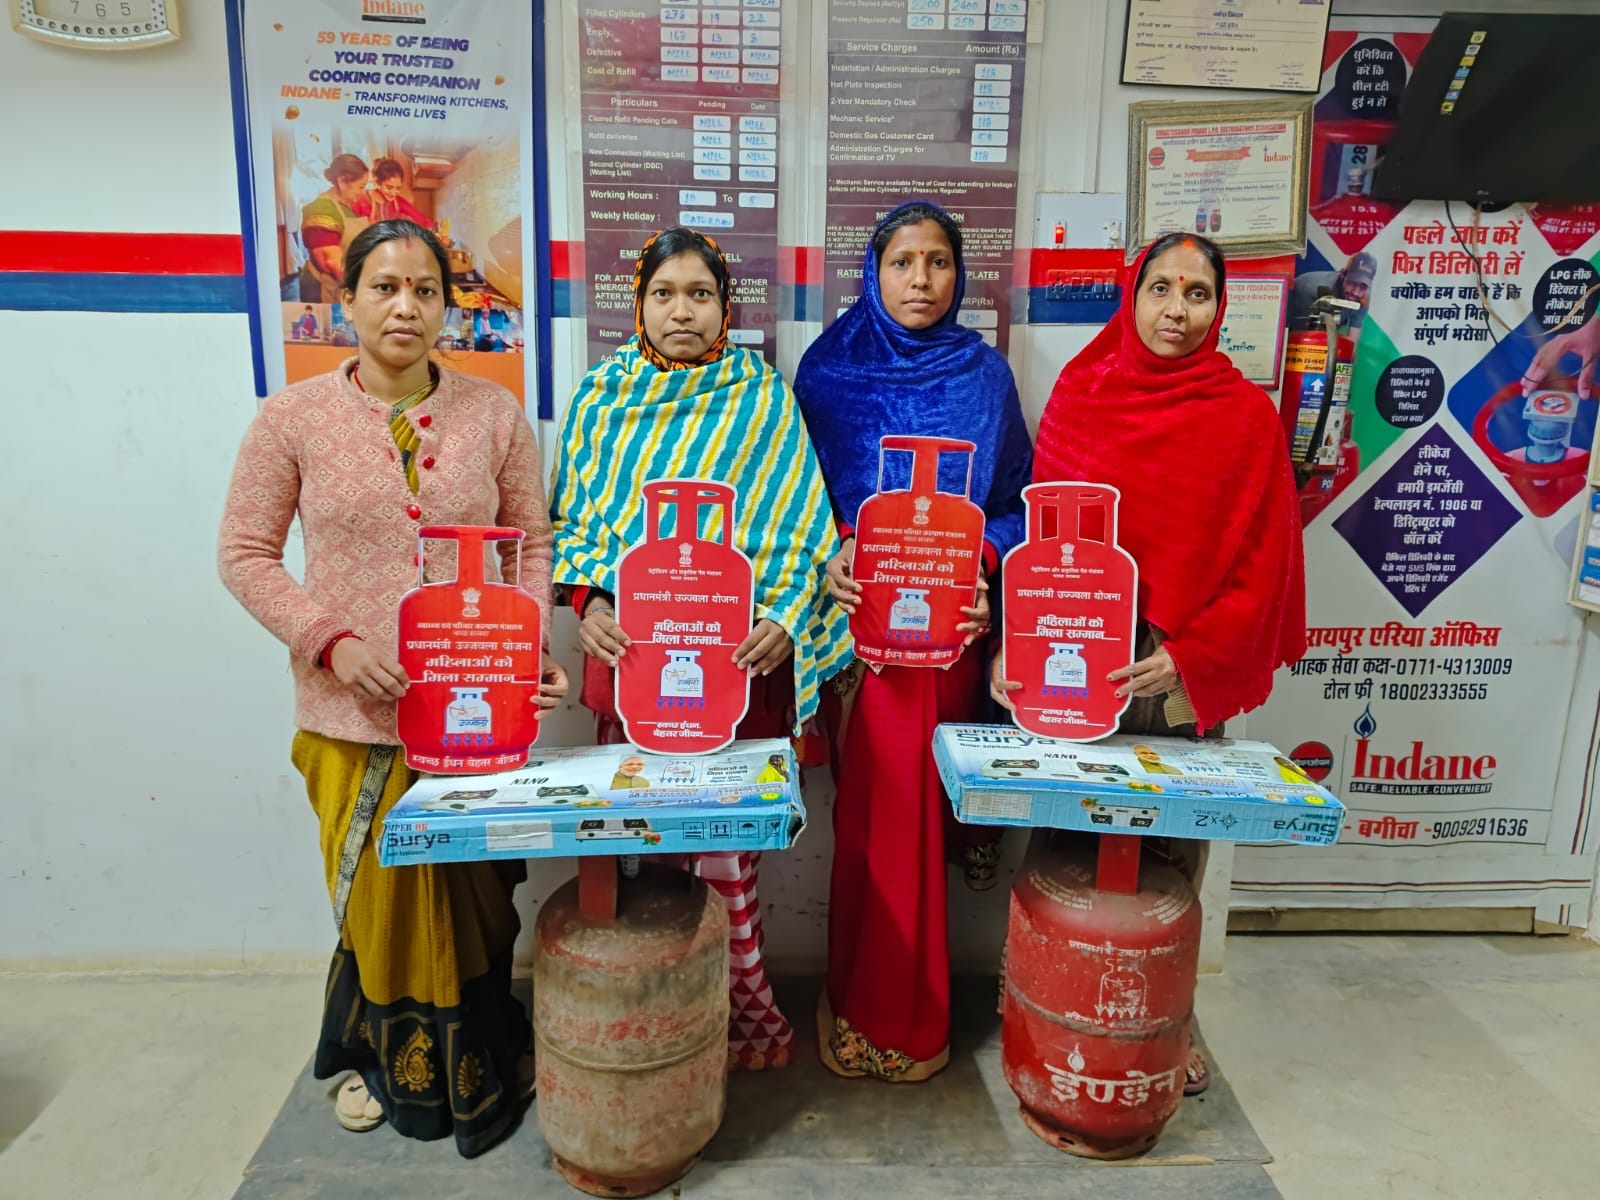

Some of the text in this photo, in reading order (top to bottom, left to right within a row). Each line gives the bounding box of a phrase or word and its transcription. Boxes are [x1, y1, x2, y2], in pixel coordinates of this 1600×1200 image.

[96, 3, 106, 17] 6
[120, 2, 131, 16] 5
[362, 0, 424, 15] Indane
[317, 31, 469, 51] 59 YEARS OF BEING
[847, 42, 918, 54] Service Charges
[966, 44, 1019, 55] Amount (Rs)
[334, 50, 454, 70] YOUR TRUSTED
[587, 67, 616, 75] Cost of
[831, 64, 960, 76] Installation Administration Charges
[1372, 64, 1384, 76] कि
[308, 69, 480, 90] COOKING COMPANION
[830, 80, 842, 88] Hot
[864, 82, 902, 90] Inspection
[1352, 80, 1372, 92] सील
[280, 84, 508, 110] INDANE TRANSFORMING KITCHENS,
[610, 98, 658, 108] Particulars
[854, 98, 917, 107] Mandatory Check
[1352, 95, 1387, 110] हुई न हो
[699, 101, 726, 109] Pending
[348, 105, 446, 120] ENRICHING LIVES
[830, 145, 881, 153] Administration
[883, 146, 912, 154] Charges
[1352, 145, 1368, 164] 28
[590, 190, 653, 201] Working Hours
[722, 194, 733, 202] To
[590, 211, 656, 222] Weekly Holiday
[1404, 219, 1524, 246] पहले करें
[1392, 250, 1425, 274] फिर
[1504, 250, 1526, 275] लें
[595, 274, 611, 282] FOR
[837, 269, 864, 278] RATES
[1550, 268, 1592, 280] LPG लीक
[736, 288, 768, 296] INDANE,
[1390, 282, 1522, 300] क्योंकि हम हैं कि
[1549, 282, 1579, 295] डिटेक्टर
[841, 296, 860, 304] HOT
[1545, 298, 1573, 310] लीकेज
[1416, 303, 1461, 320] आपको
[600, 330, 622, 338] Name
[1414, 324, 1489, 345] संपूर्ण भरोसा
[1412, 390, 1428, 398] LPG
[1418, 444, 1451, 458] लीकेज
[1414, 462, 1432, 476] होने
[1398, 480, 1424, 494] हमारी
[1374, 496, 1482, 512] हेल्पलाइन 1906 या
[1442, 514, 1456, 528] को
[1404, 531, 1444, 544] कॉल करें
[862, 542, 974, 559] प्रधानमंत्री योजना
[877, 558, 954, 573] महिलाओं को
[1408, 564, 1424, 572] SMS
[874, 571, 955, 588] मिला सम्मान
[633, 590, 671, 602] प्रधानमंत्री
[712, 592, 739, 604] योजना
[1016, 588, 1054, 598] प्रधानमंत्री
[1094, 590, 1121, 601] योजना
[654, 619, 722, 633] महिलाओं को
[1037, 614, 1104, 628] महिलाओं को
[652, 632, 722, 645] मिला सम्मान
[1036, 626, 1105, 640] मिला सम्मान
[1306, 620, 1502, 655] रायपुर एरिया ऑफिस
[406, 638, 532, 651] प्रधानमंत्री योजना
[426, 654, 513, 668] महिलाओं को
[1332, 653, 1358, 674] सेवा
[1362, 656, 1513, 676] कक्ष-0771-4313009
[423, 670, 516, 683] मिला सम्मान
[1323, 678, 1488, 700] टोल फ्री 18002333555
[956, 733, 1056, 746] Surya
[1351, 738, 1497, 781] Indane
[510, 777, 550, 786] NANO
[1274, 820, 1336, 838] Surya
[1358, 816, 1420, 840] बगीचा
[388, 832, 450, 849] Surya
[1044, 1063, 1180, 1106] इण्डेन
